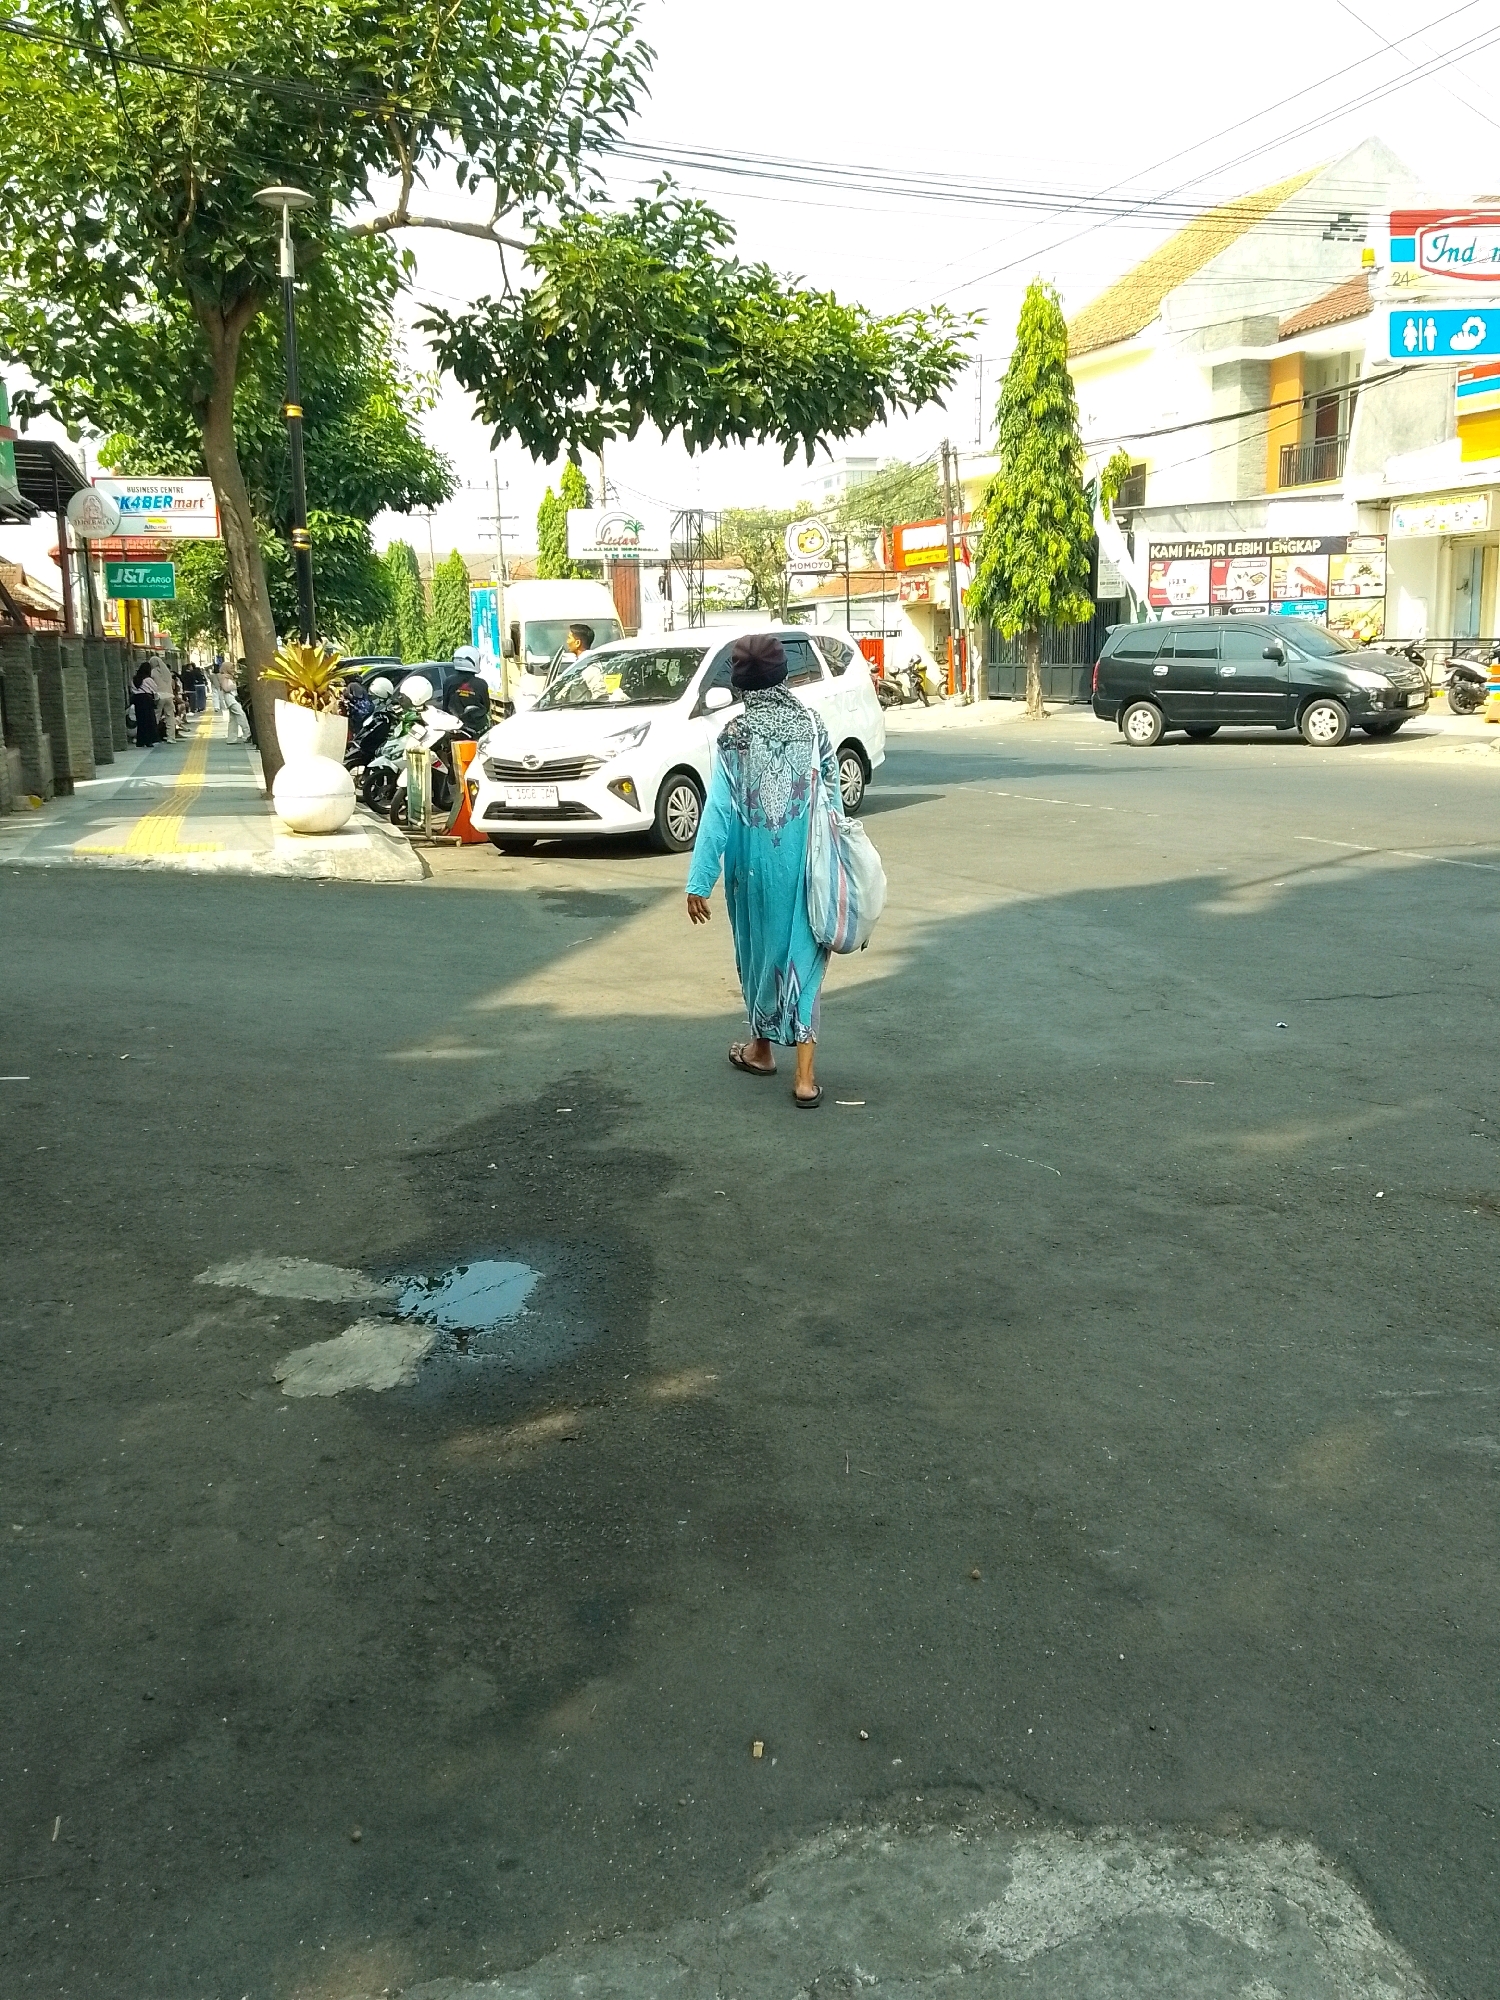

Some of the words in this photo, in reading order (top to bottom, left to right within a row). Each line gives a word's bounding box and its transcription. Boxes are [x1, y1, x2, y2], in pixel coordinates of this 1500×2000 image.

[126, 486, 159, 494] BUSINESS
[1150, 543, 1182, 559] KAMI
[1185, 542, 1226, 558] HADIR
[1228, 541, 1262, 556] LEBIH
[1265, 539, 1322, 555] LENGKAP
[789, 561, 830, 570] MOMOYO
[110, 568, 152, 584] J&T
[146, 576, 172, 584] CARGO
